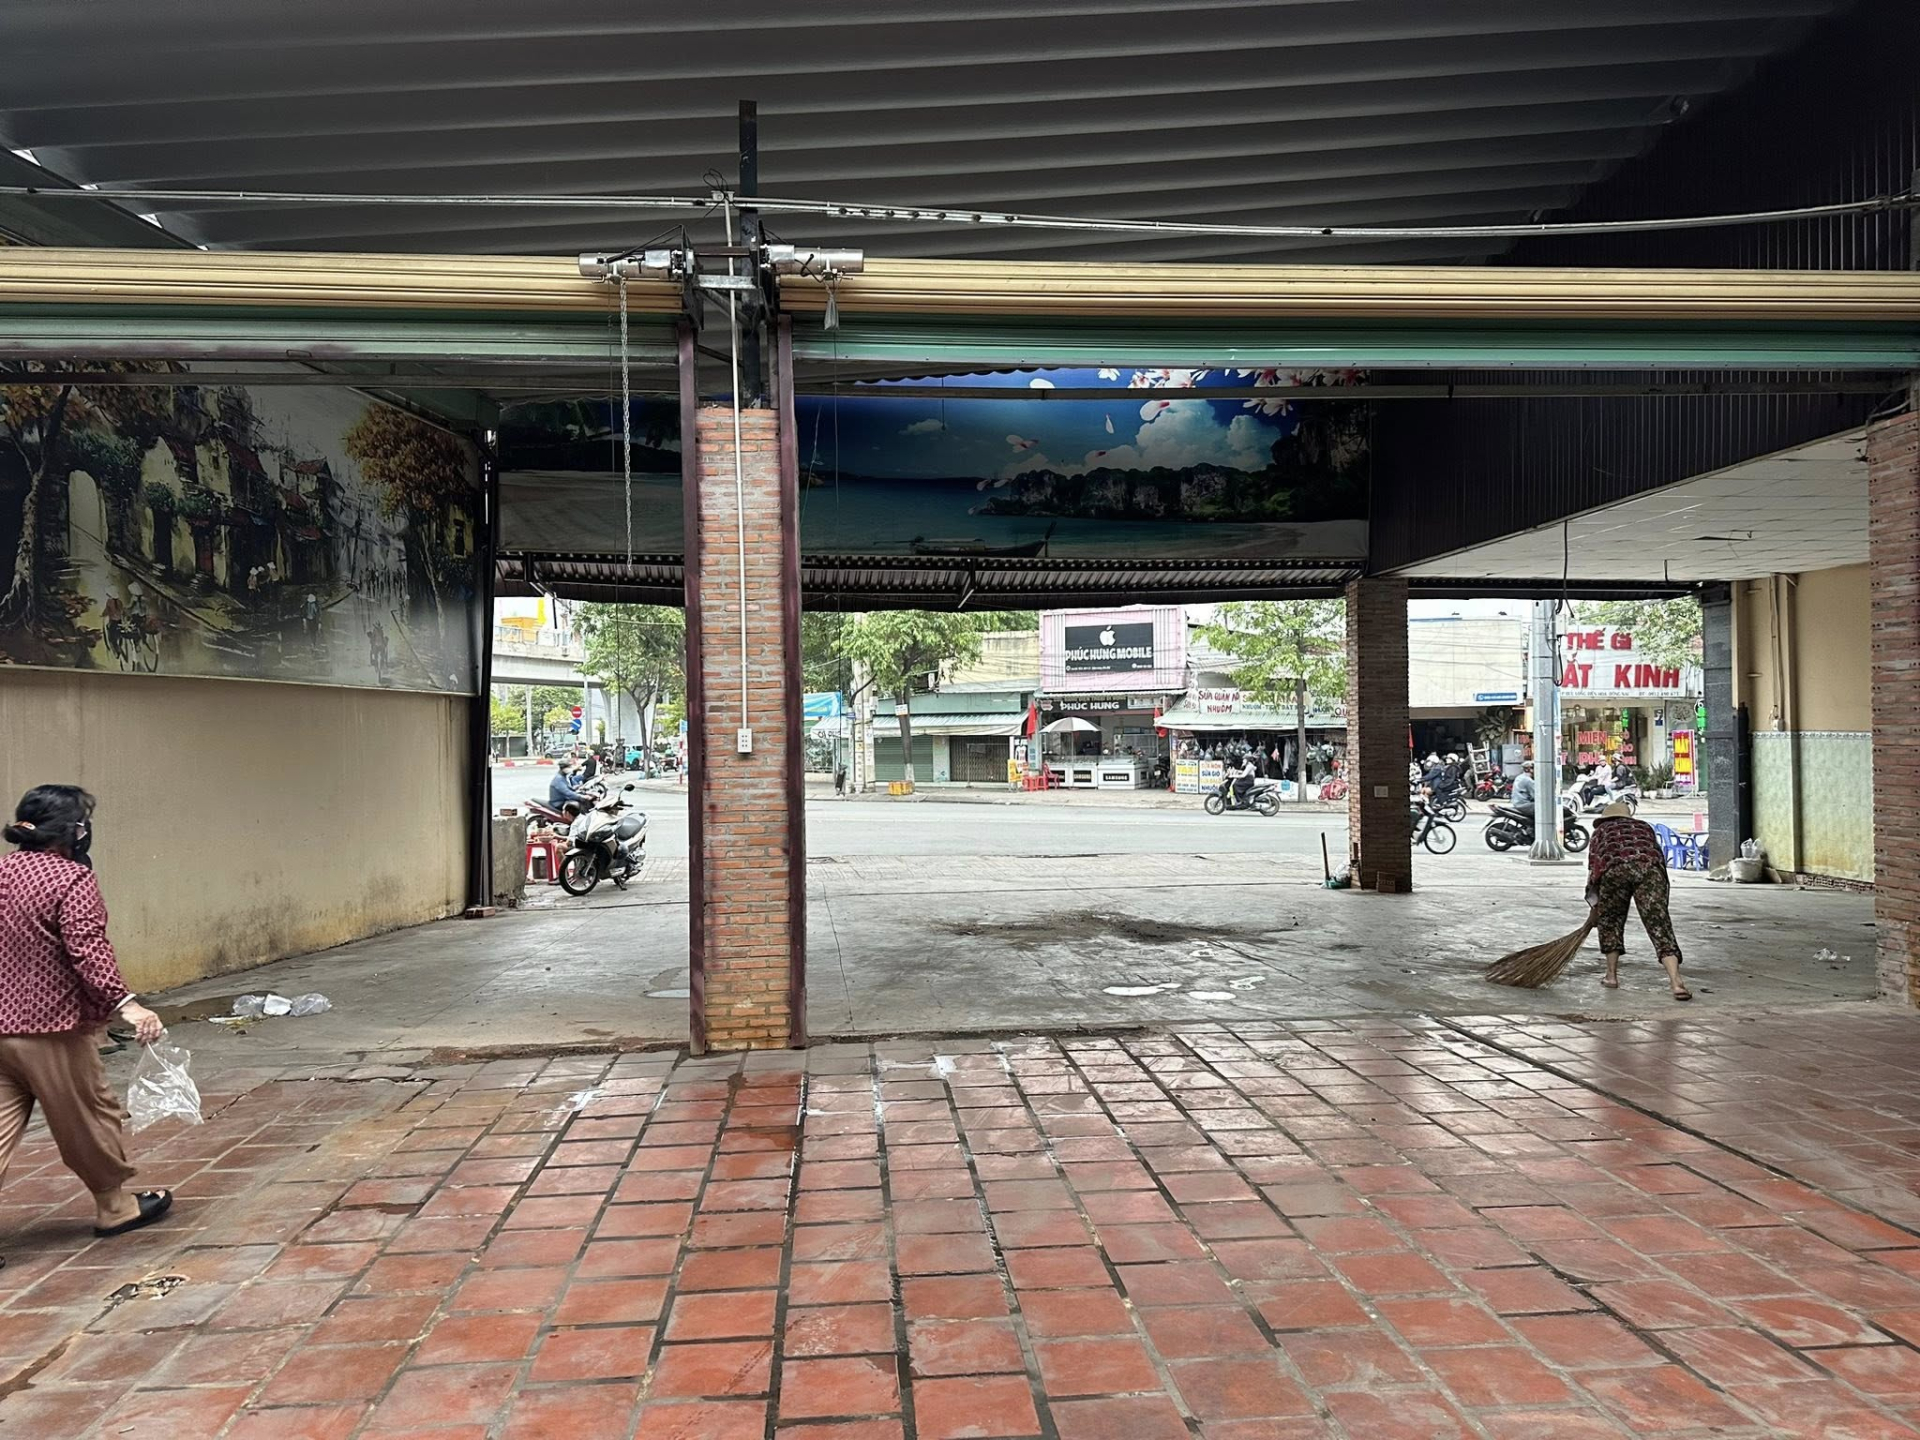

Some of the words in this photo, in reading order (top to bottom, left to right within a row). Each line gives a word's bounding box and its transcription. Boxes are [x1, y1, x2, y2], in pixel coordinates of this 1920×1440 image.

[1567, 627, 1606, 650] THẾ
[1065, 646, 1089, 661] PHÚC
[1117, 646, 1152, 659] MOBILE
[1561, 652, 1593, 688] ẮT
